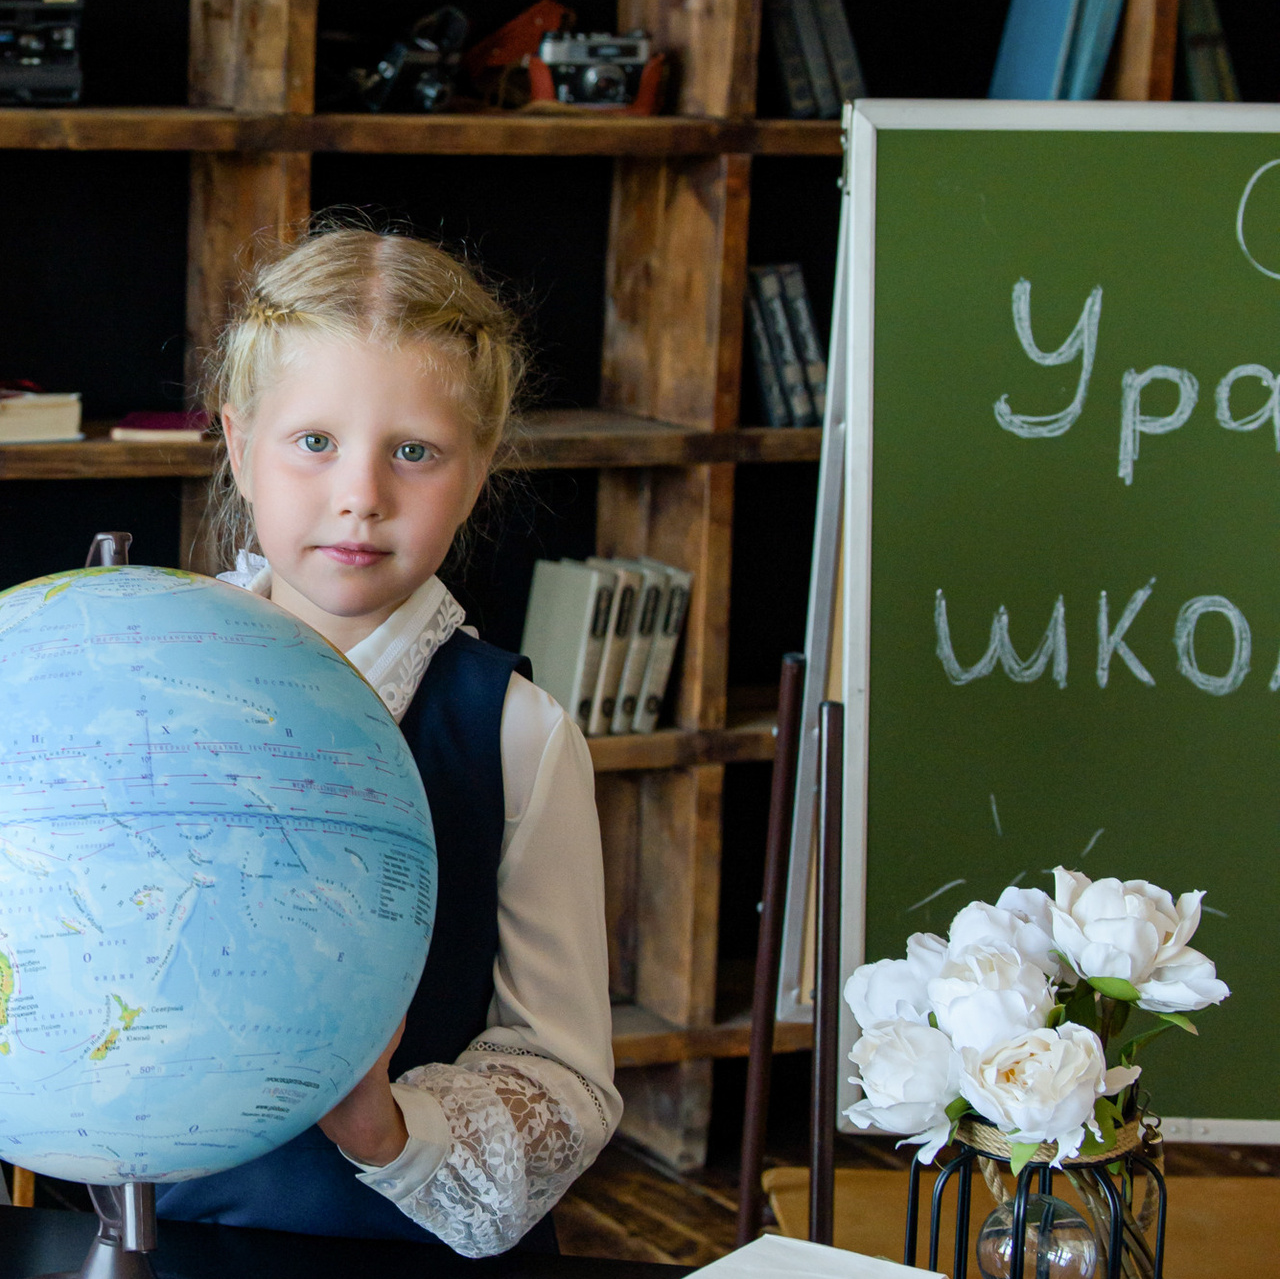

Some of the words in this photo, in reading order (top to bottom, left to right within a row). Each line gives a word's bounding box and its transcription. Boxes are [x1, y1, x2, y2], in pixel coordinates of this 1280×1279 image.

[126, 624, 141, 632] 40°
[934, 576, 1280, 698] шко
[130, 664, 145, 672] 30°
[136, 709, 148, 717] 20°
[145, 956, 160, 965] 30°
[6, 1002, 39, 1012] Канберра
[151, 1005, 184, 1014] Северный
[139, 1065, 156, 1074] 50°
[135, 1114, 151, 1122] 60°
